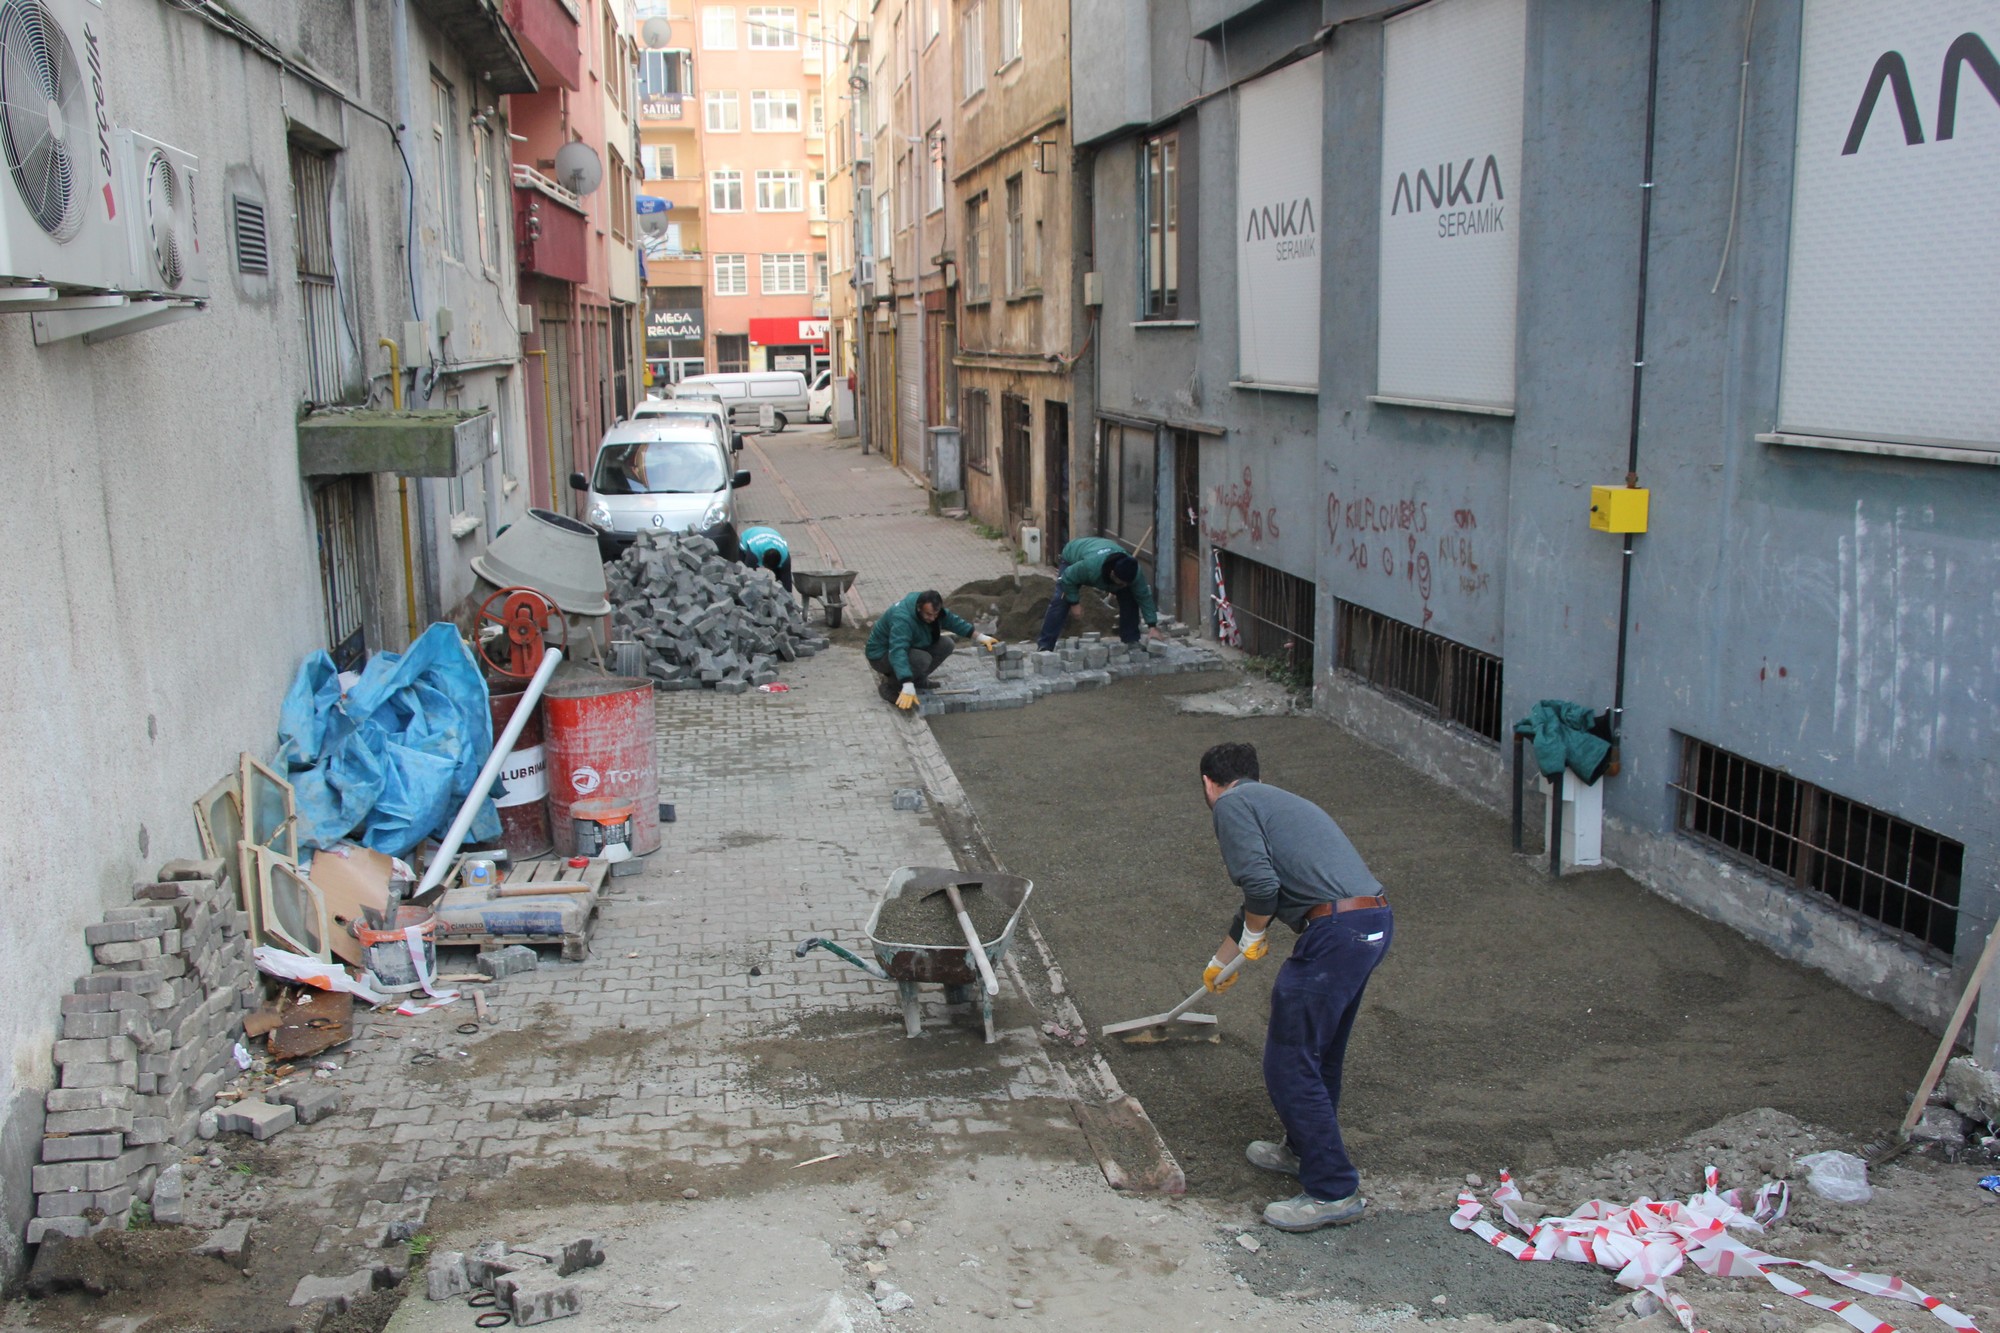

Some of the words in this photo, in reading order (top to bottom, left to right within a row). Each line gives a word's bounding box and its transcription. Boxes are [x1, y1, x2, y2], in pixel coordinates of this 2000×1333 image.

[84, 22, 112, 177] arçelik
[643, 103, 681, 115] SATILIK
[1391, 154, 1504, 216] ANKA
[1247, 197, 1315, 242] ANKA
[1438, 202, 1504, 238] SERAMİK
[647, 325, 701, 337] REKLAM
[655, 312, 692, 324] MEGA
